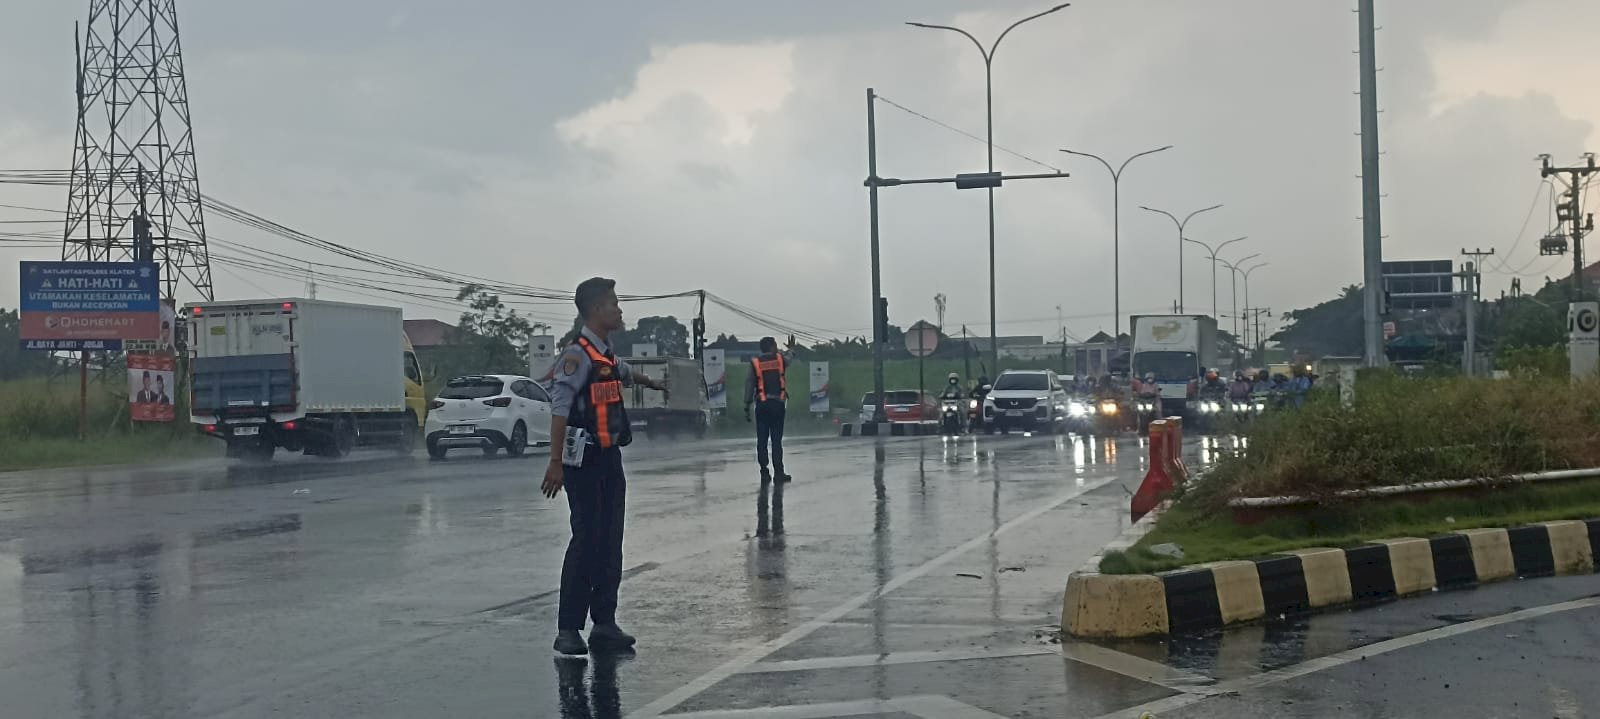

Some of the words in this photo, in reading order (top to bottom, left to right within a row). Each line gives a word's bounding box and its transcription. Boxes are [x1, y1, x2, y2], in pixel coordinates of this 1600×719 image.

[58, 278, 122, 289] HATI-HATI
[29, 292, 82, 300] UTAMAKAN
[83, 292, 151, 301] KESELAMATAN
[52, 301, 81, 309] BUKAN
[82, 301, 128, 309] KECEPATAN
